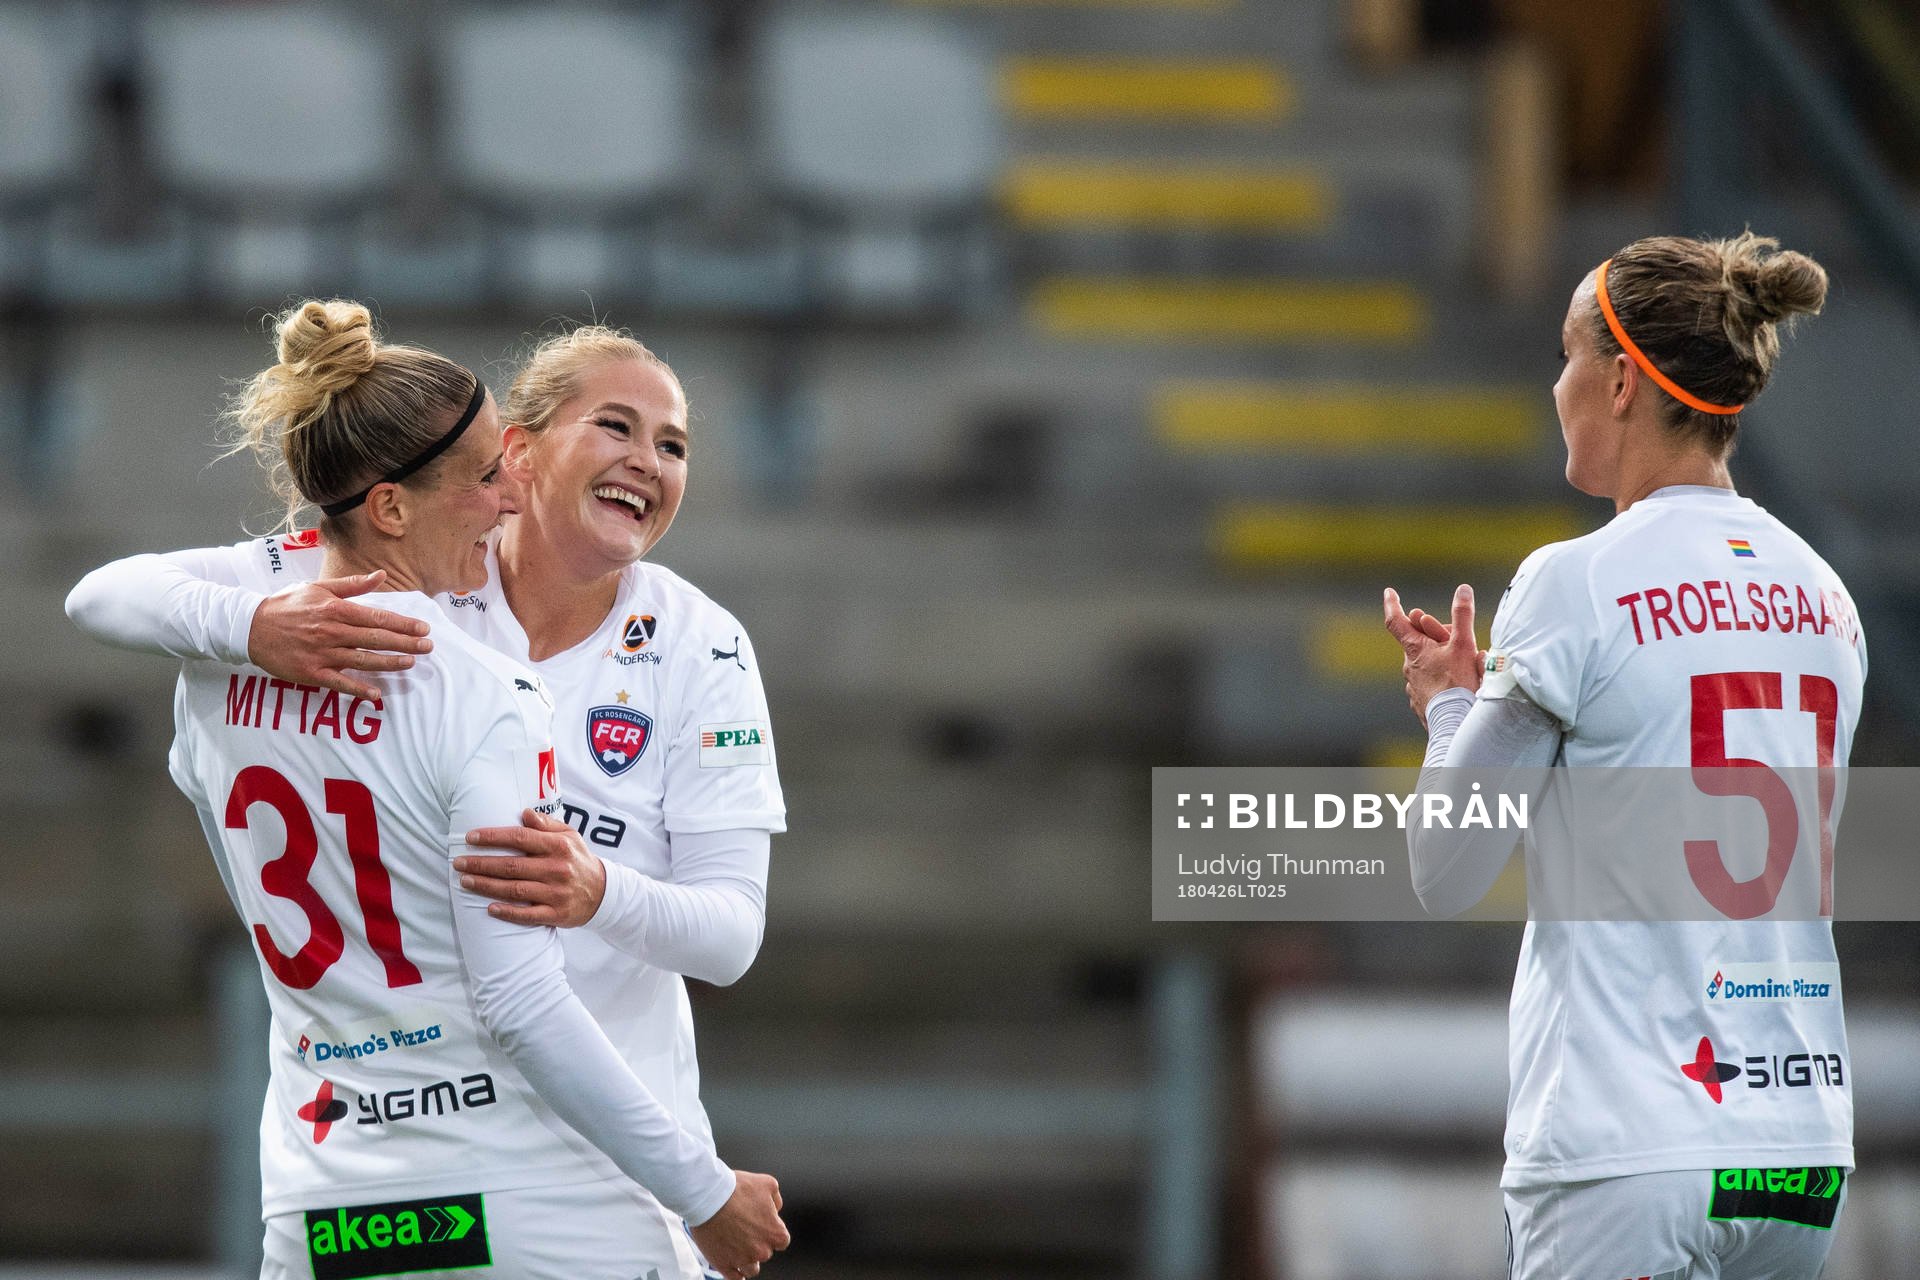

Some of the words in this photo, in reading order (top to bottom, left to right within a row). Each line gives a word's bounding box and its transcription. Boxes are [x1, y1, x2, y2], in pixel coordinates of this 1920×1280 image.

[267, 547, 282, 573] SPEL
[225, 673, 384, 744] MITTAG
[595, 711, 604, 719] FC
[595, 722, 641, 745] FCR
[714, 728, 761, 747] PEA
[1683, 671, 1838, 920] 51
[225, 765, 423, 990] 31
[1793, 978, 1830, 998] Pizza
[390, 1024, 442, 1047] Pizza
[312, 1206, 423, 1256] akea
